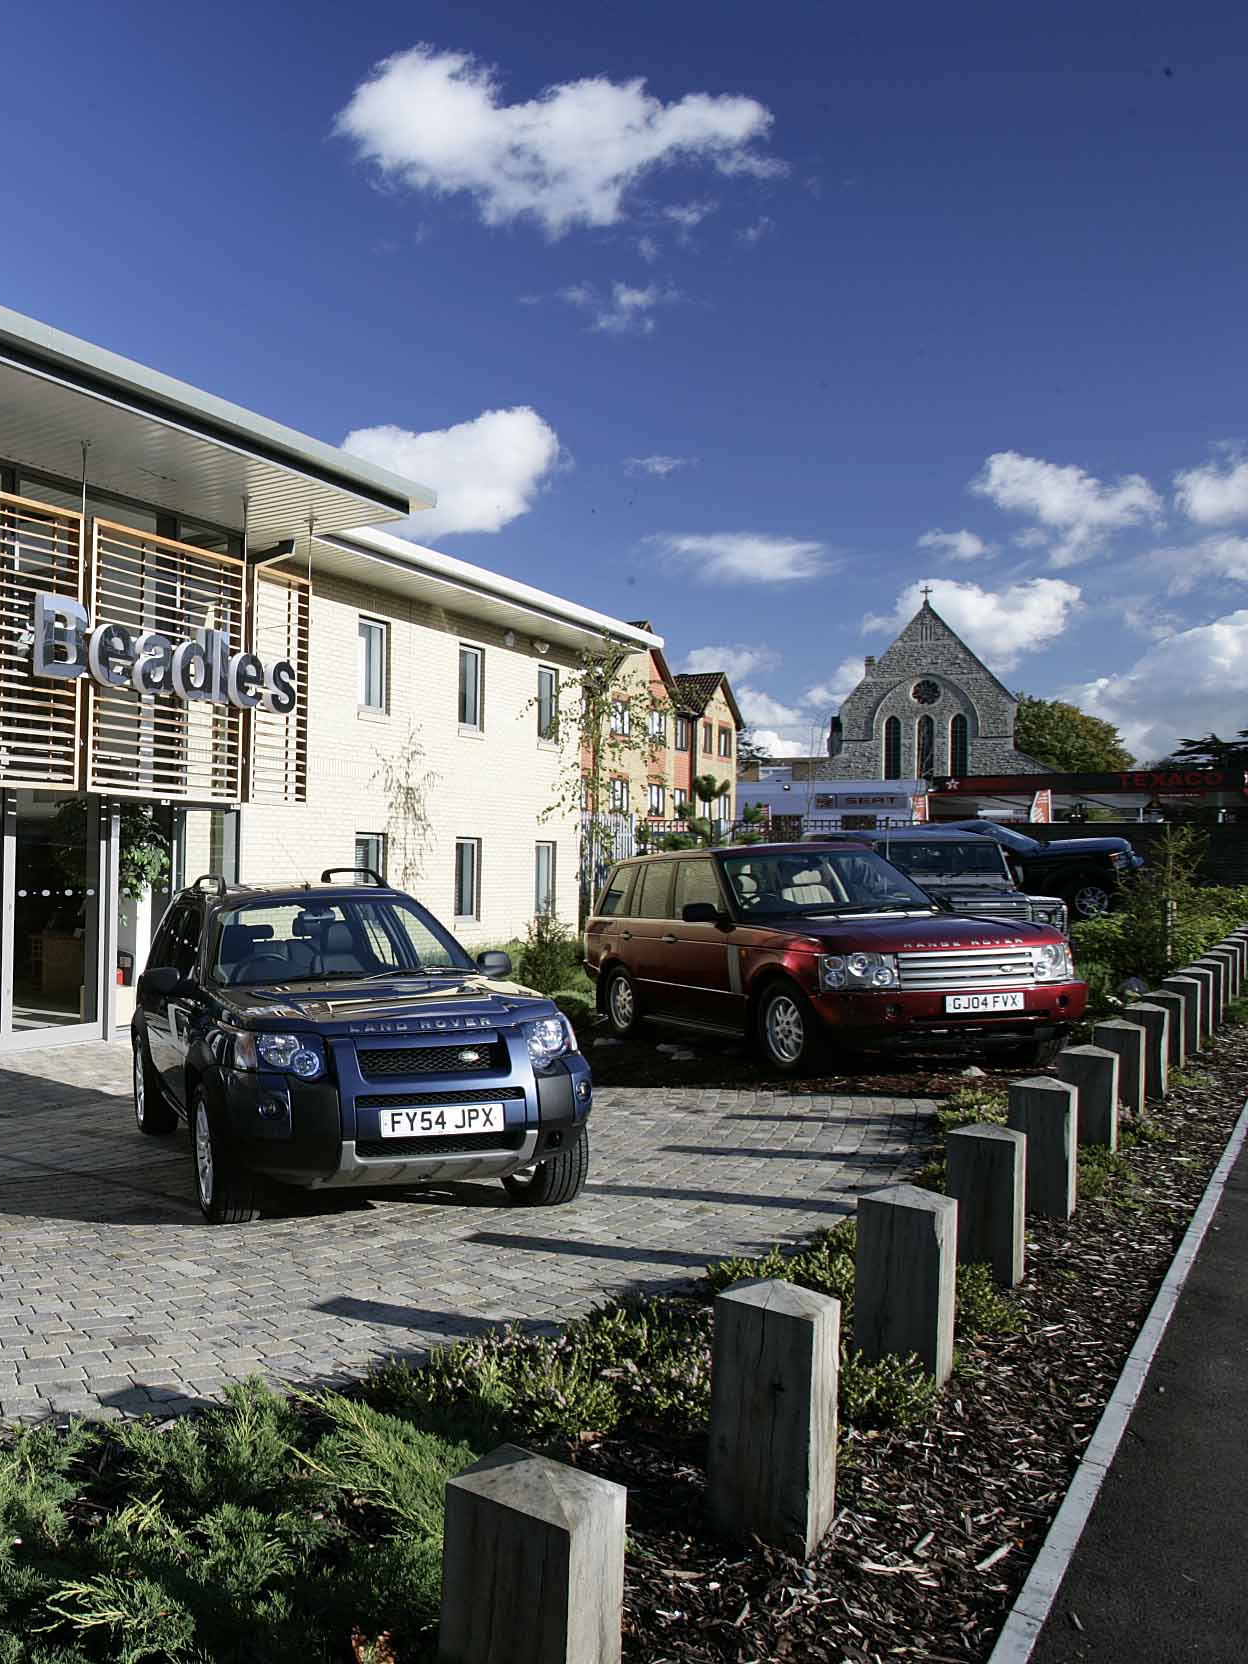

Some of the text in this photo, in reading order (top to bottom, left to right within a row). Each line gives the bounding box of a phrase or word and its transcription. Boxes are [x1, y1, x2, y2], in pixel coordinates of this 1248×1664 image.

[33, 592, 296, 714] Beadles
[1120, 771, 1225, 788] TEXACO
[952, 994, 1018, 1010] GJ04 FVX
[349, 1017, 492, 1033] LAND ROVER
[390, 1107, 495, 1133] FY54 JPX
